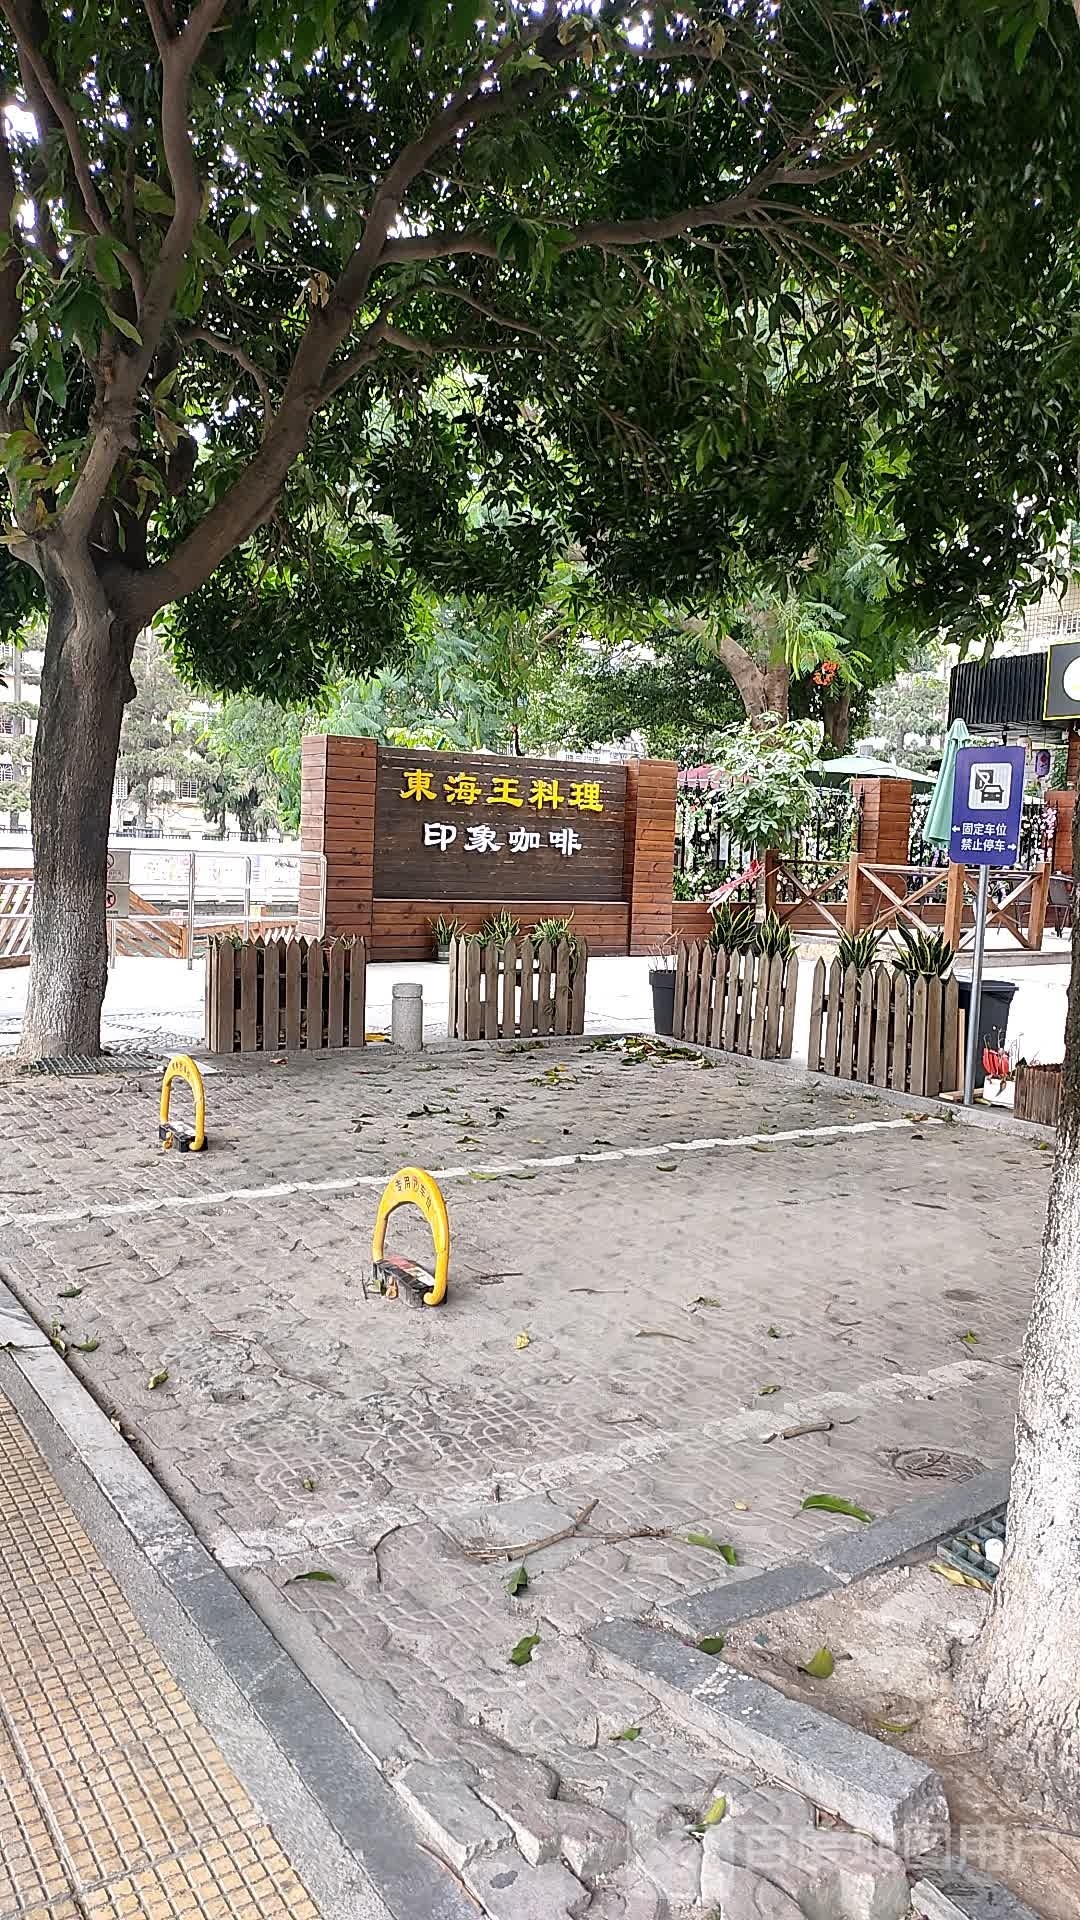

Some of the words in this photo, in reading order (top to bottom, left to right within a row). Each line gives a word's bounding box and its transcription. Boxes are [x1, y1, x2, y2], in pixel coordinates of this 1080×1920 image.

[400, 768, 604, 812] 東海王料理
[424, 822, 582, 856] 印象咖啡
[961, 822, 1007, 836] 固定车位
[960, 838, 1006, 852] 禁止停车
